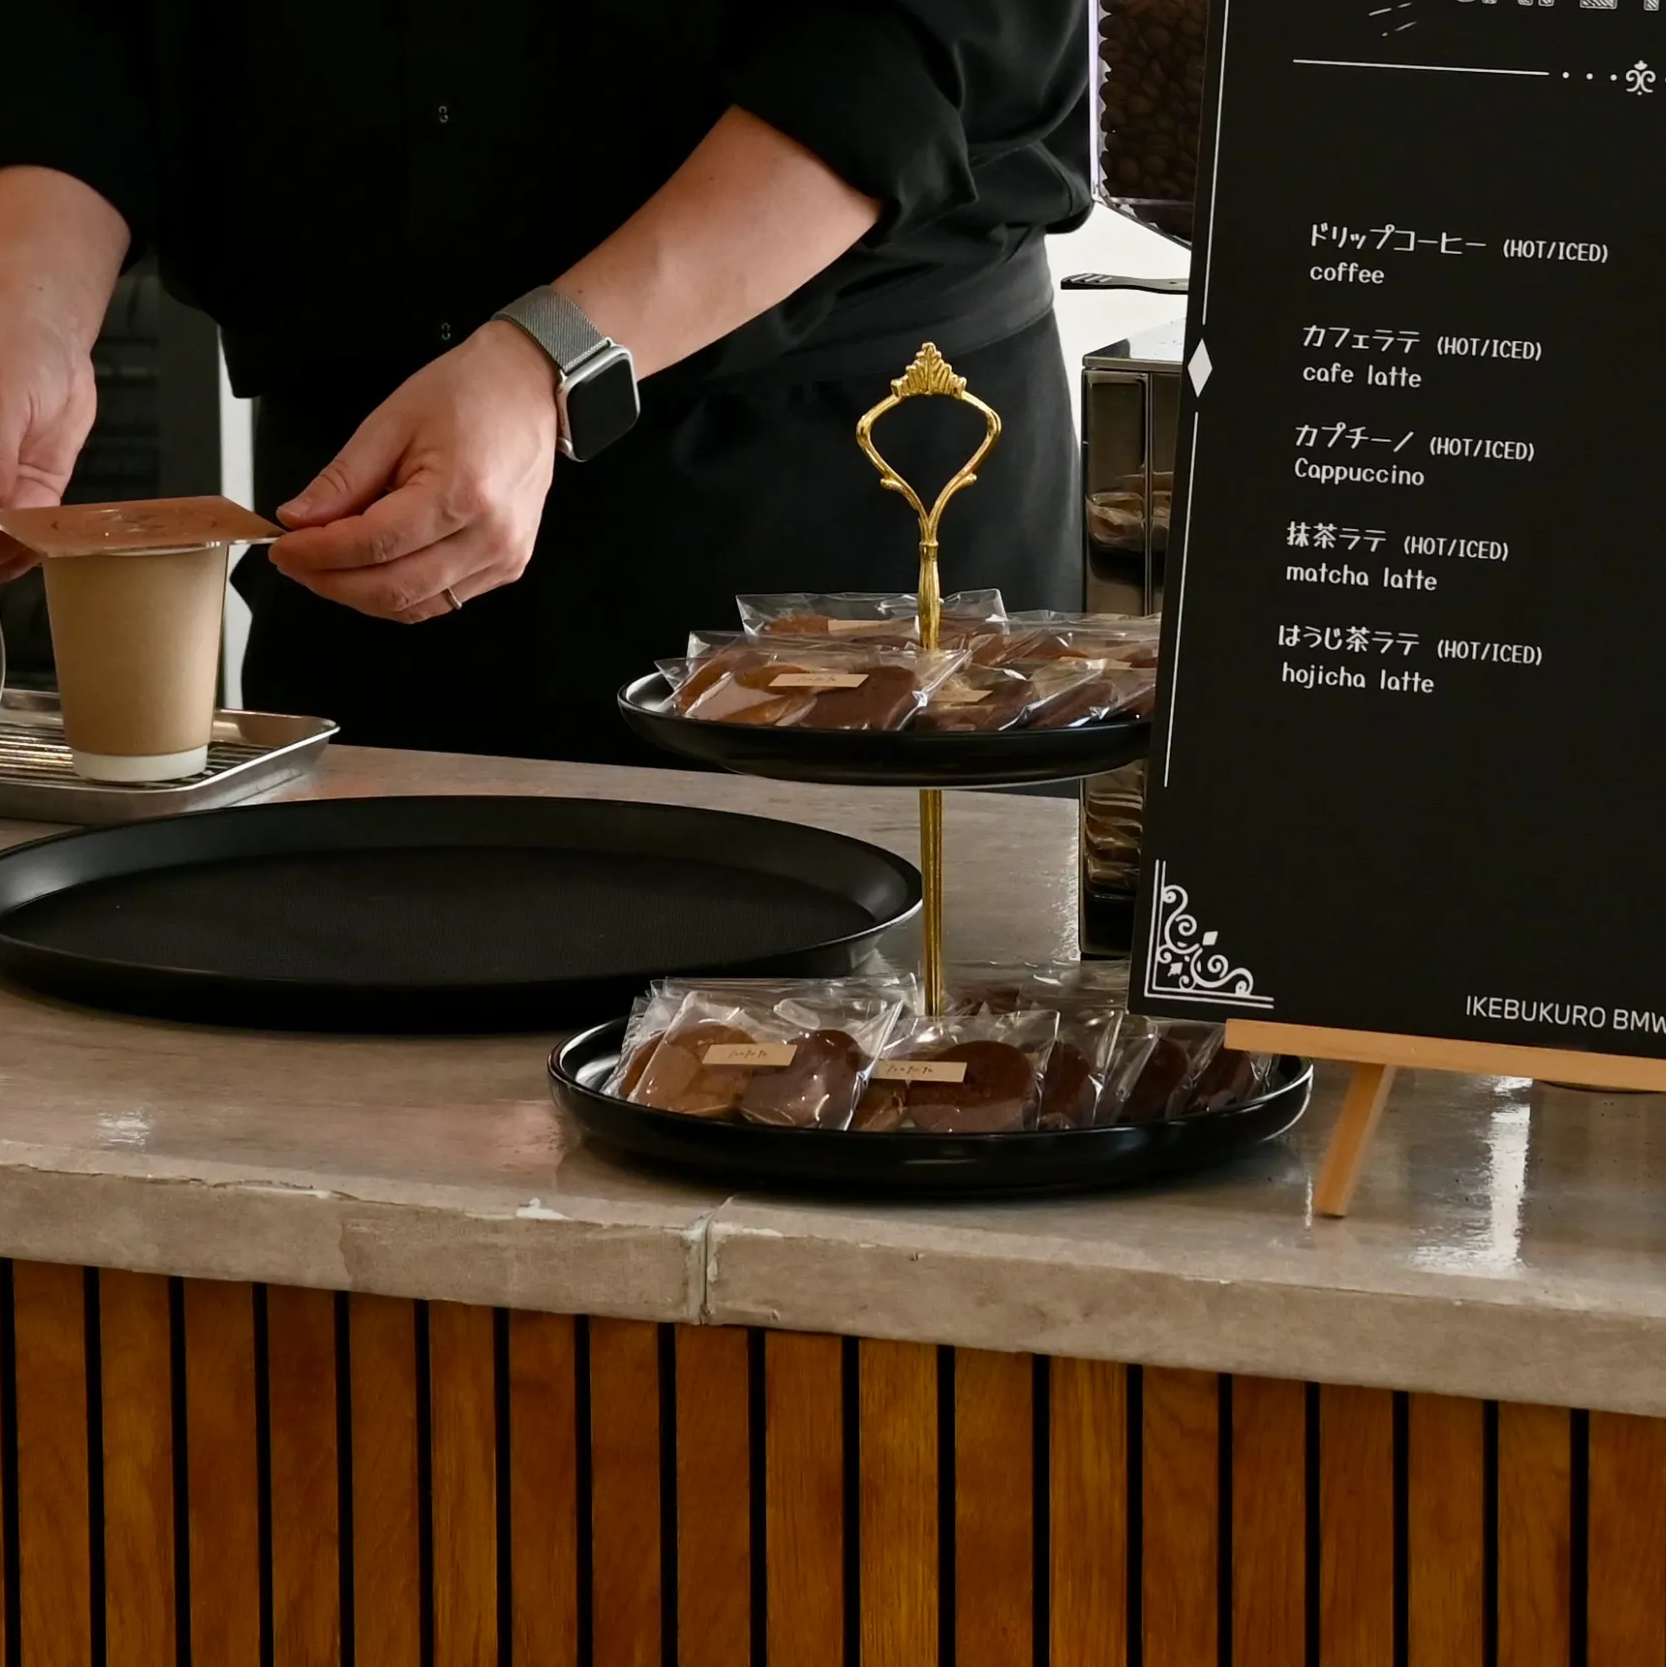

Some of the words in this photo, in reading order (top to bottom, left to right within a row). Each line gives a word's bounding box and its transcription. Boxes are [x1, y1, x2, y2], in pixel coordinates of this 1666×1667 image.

[1311, 222, 1487, 255] ドリップコーヒー
[1503, 239, 1608, 264] (HOT/ICED)
[1309, 261, 1385, 284] coffee
[1303, 324, 1420, 354] カフェラテ
[1436, 336, 1542, 362] (HOT/ICED)
[1302, 362, 1354, 384] cafe
[1367, 364, 1422, 388] latte
[1295, 421, 1414, 453] カプチーノ
[1429, 436, 1535, 462] (HOT/ICED)
[1294, 457, 1425, 486] Cappuccino
[1286, 520, 1387, 553] 抹茶ラテ
[1403, 535, 1509, 562] (HOT/ICED)
[1286, 562, 1369, 586] matcha
[1383, 567, 1438, 591] latte
[1437, 639, 1543, 666] (HOT/ICED)
[1282, 661, 1366, 689] hojicha
[1380, 669, 1435, 694] latte
[1466, 995, 1606, 1028] IKEBUKURO
